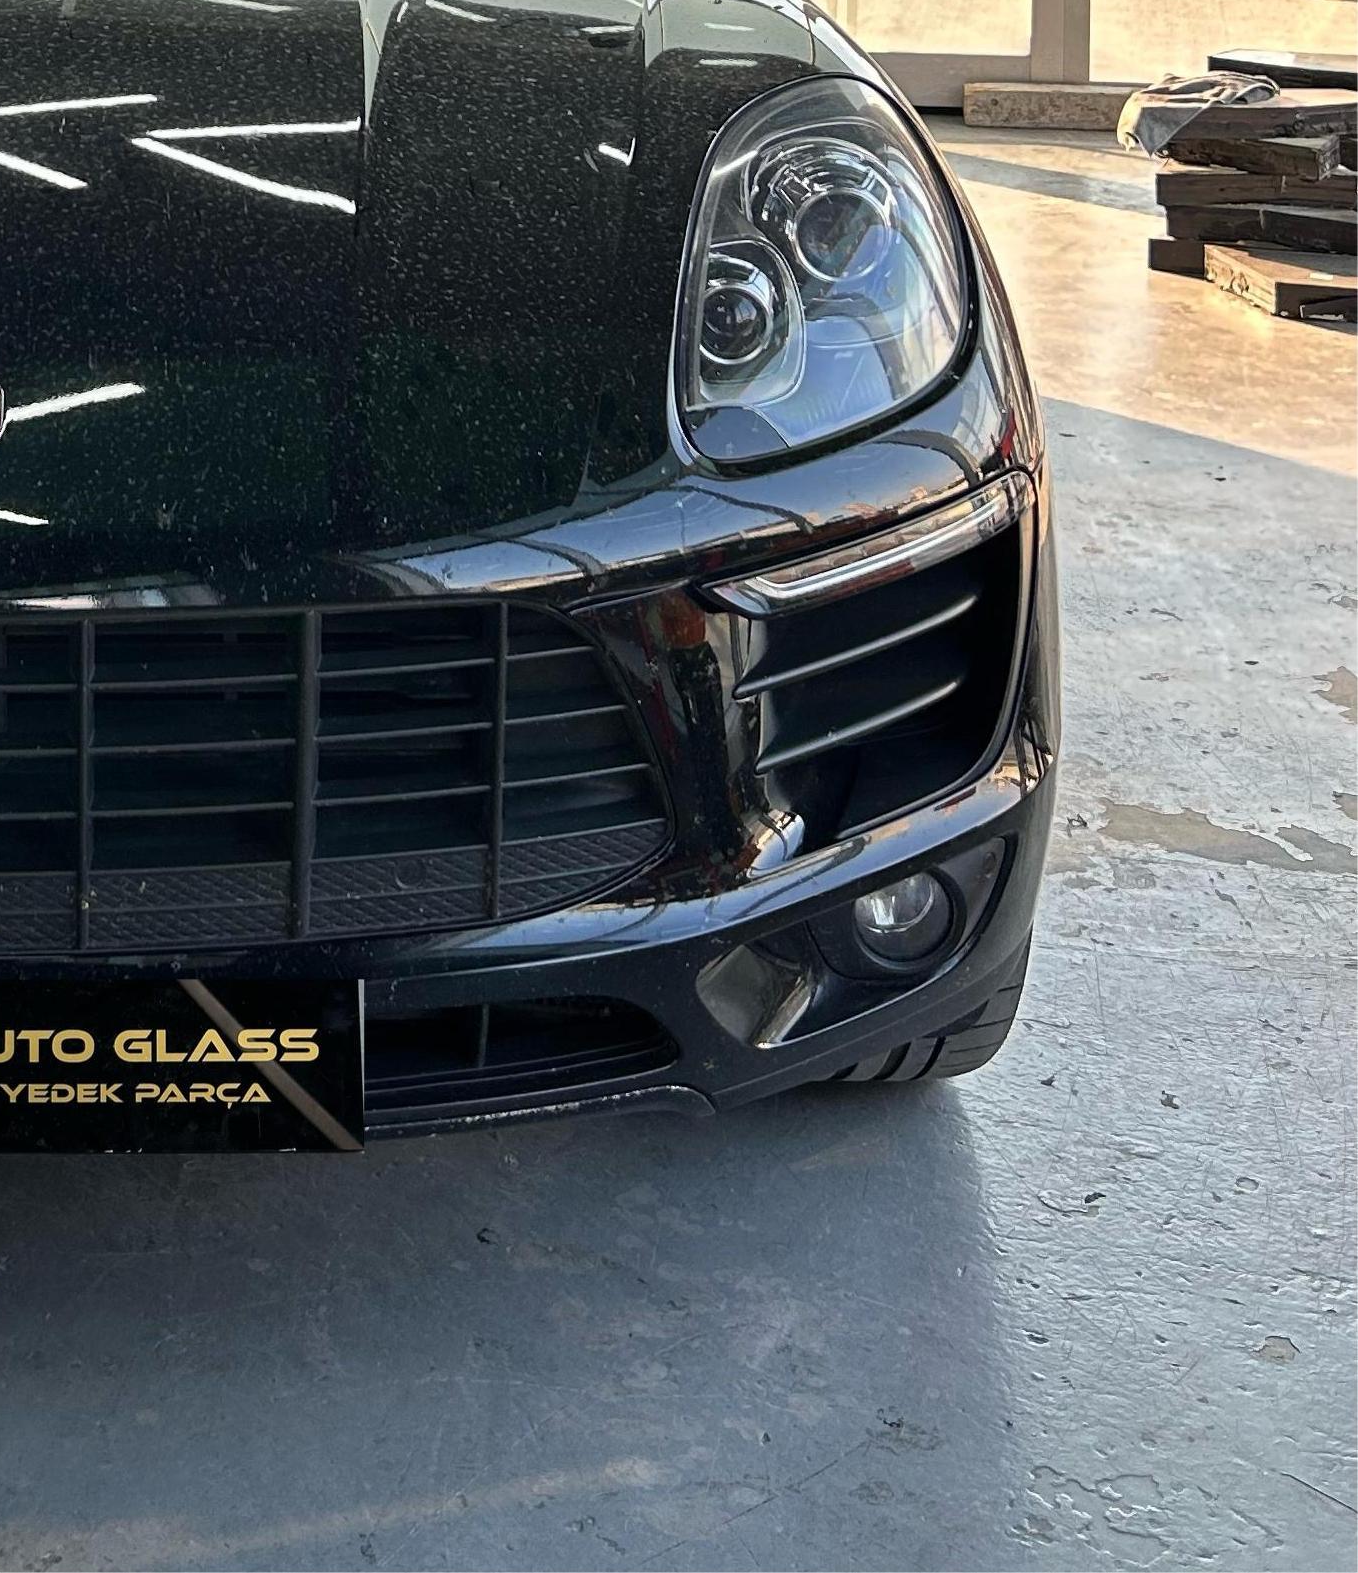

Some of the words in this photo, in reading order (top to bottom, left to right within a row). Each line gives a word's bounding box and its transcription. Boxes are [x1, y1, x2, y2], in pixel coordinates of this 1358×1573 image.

[113, 1027, 321, 1063] GLASS
[0, 1082, 124, 1104] YEDEK
[135, 1082, 272, 1111] PARÇA
